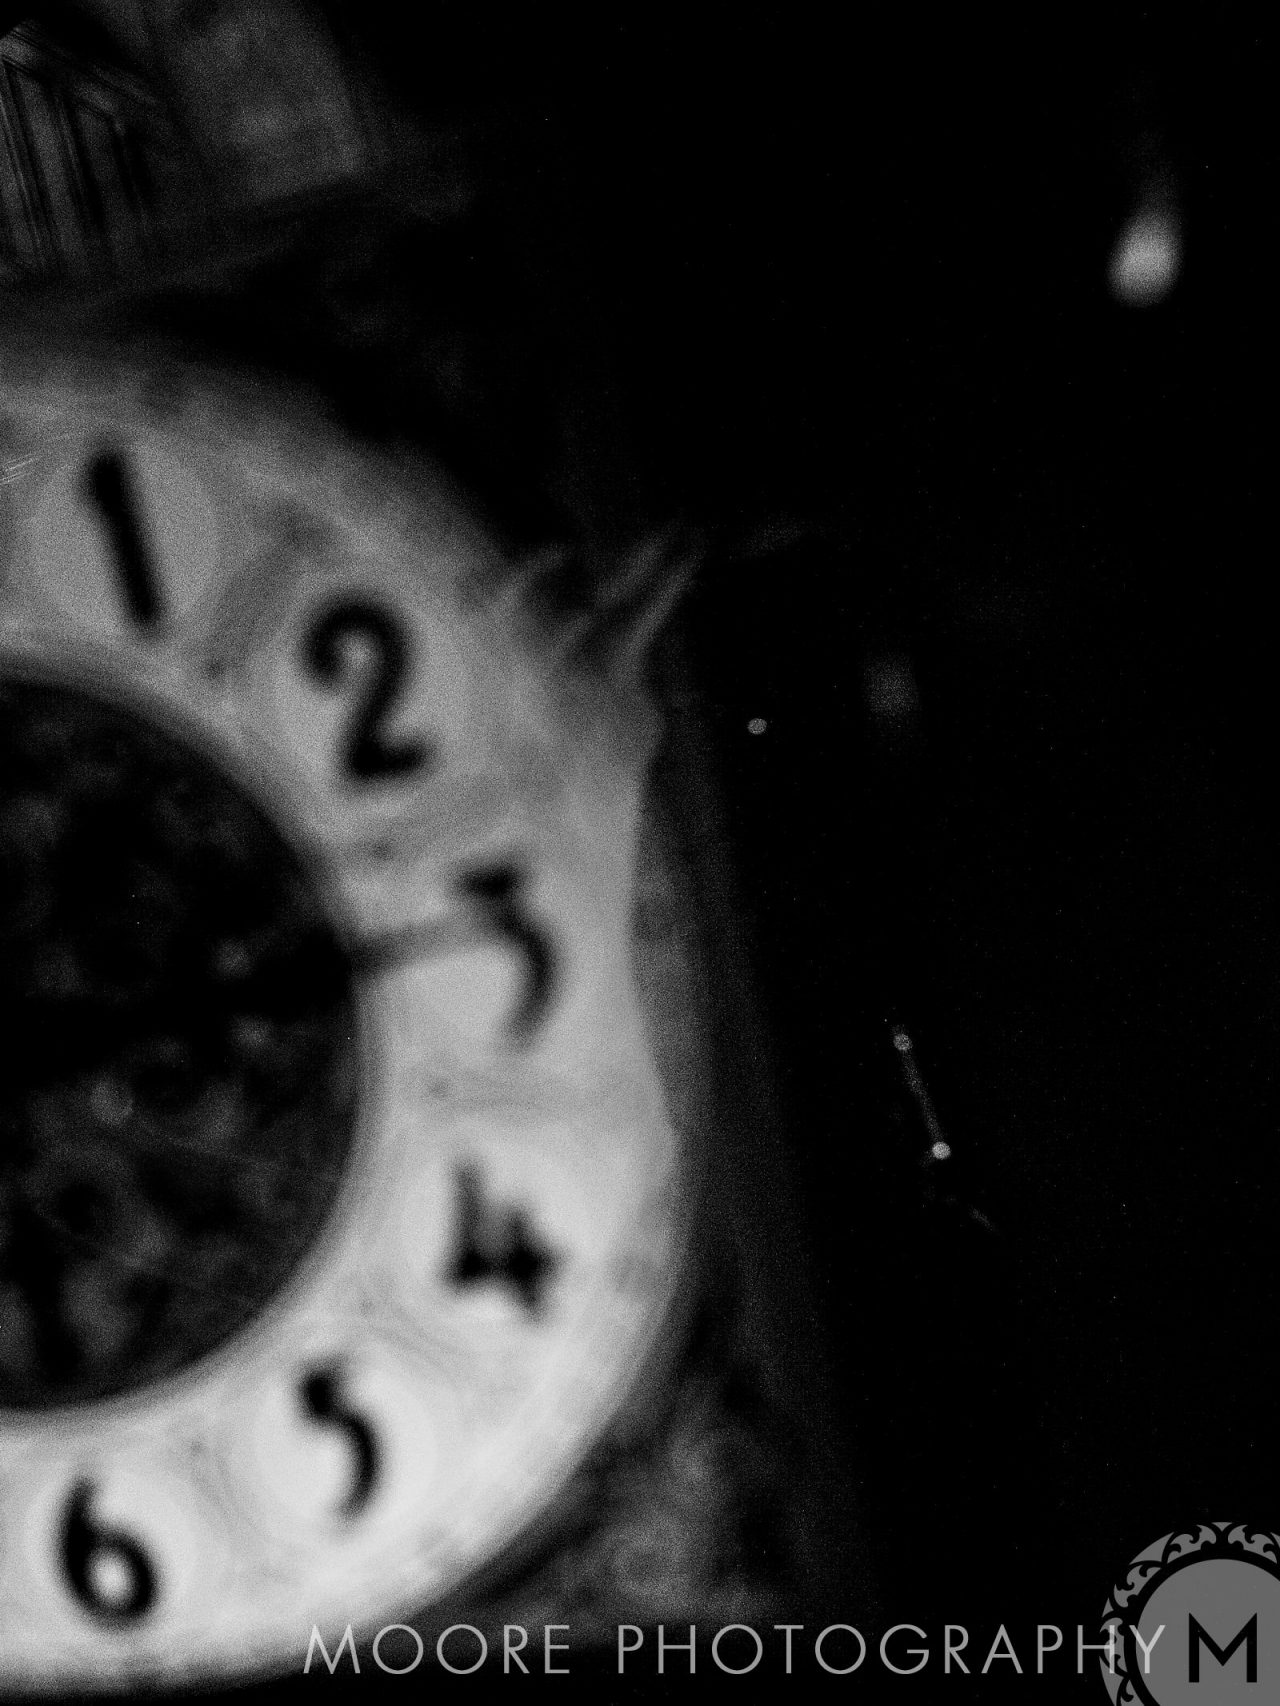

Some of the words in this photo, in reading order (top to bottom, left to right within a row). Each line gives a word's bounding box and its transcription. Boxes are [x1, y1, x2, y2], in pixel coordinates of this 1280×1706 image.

[82, 443, 163, 636] 1
[302, 590, 435, 786] 2
[447, 866, 562, 1053] 3
[437, 1158, 562, 1326] 4
[297, 1358, 383, 1534] 5
[56, 1473, 159, 1632] 6
